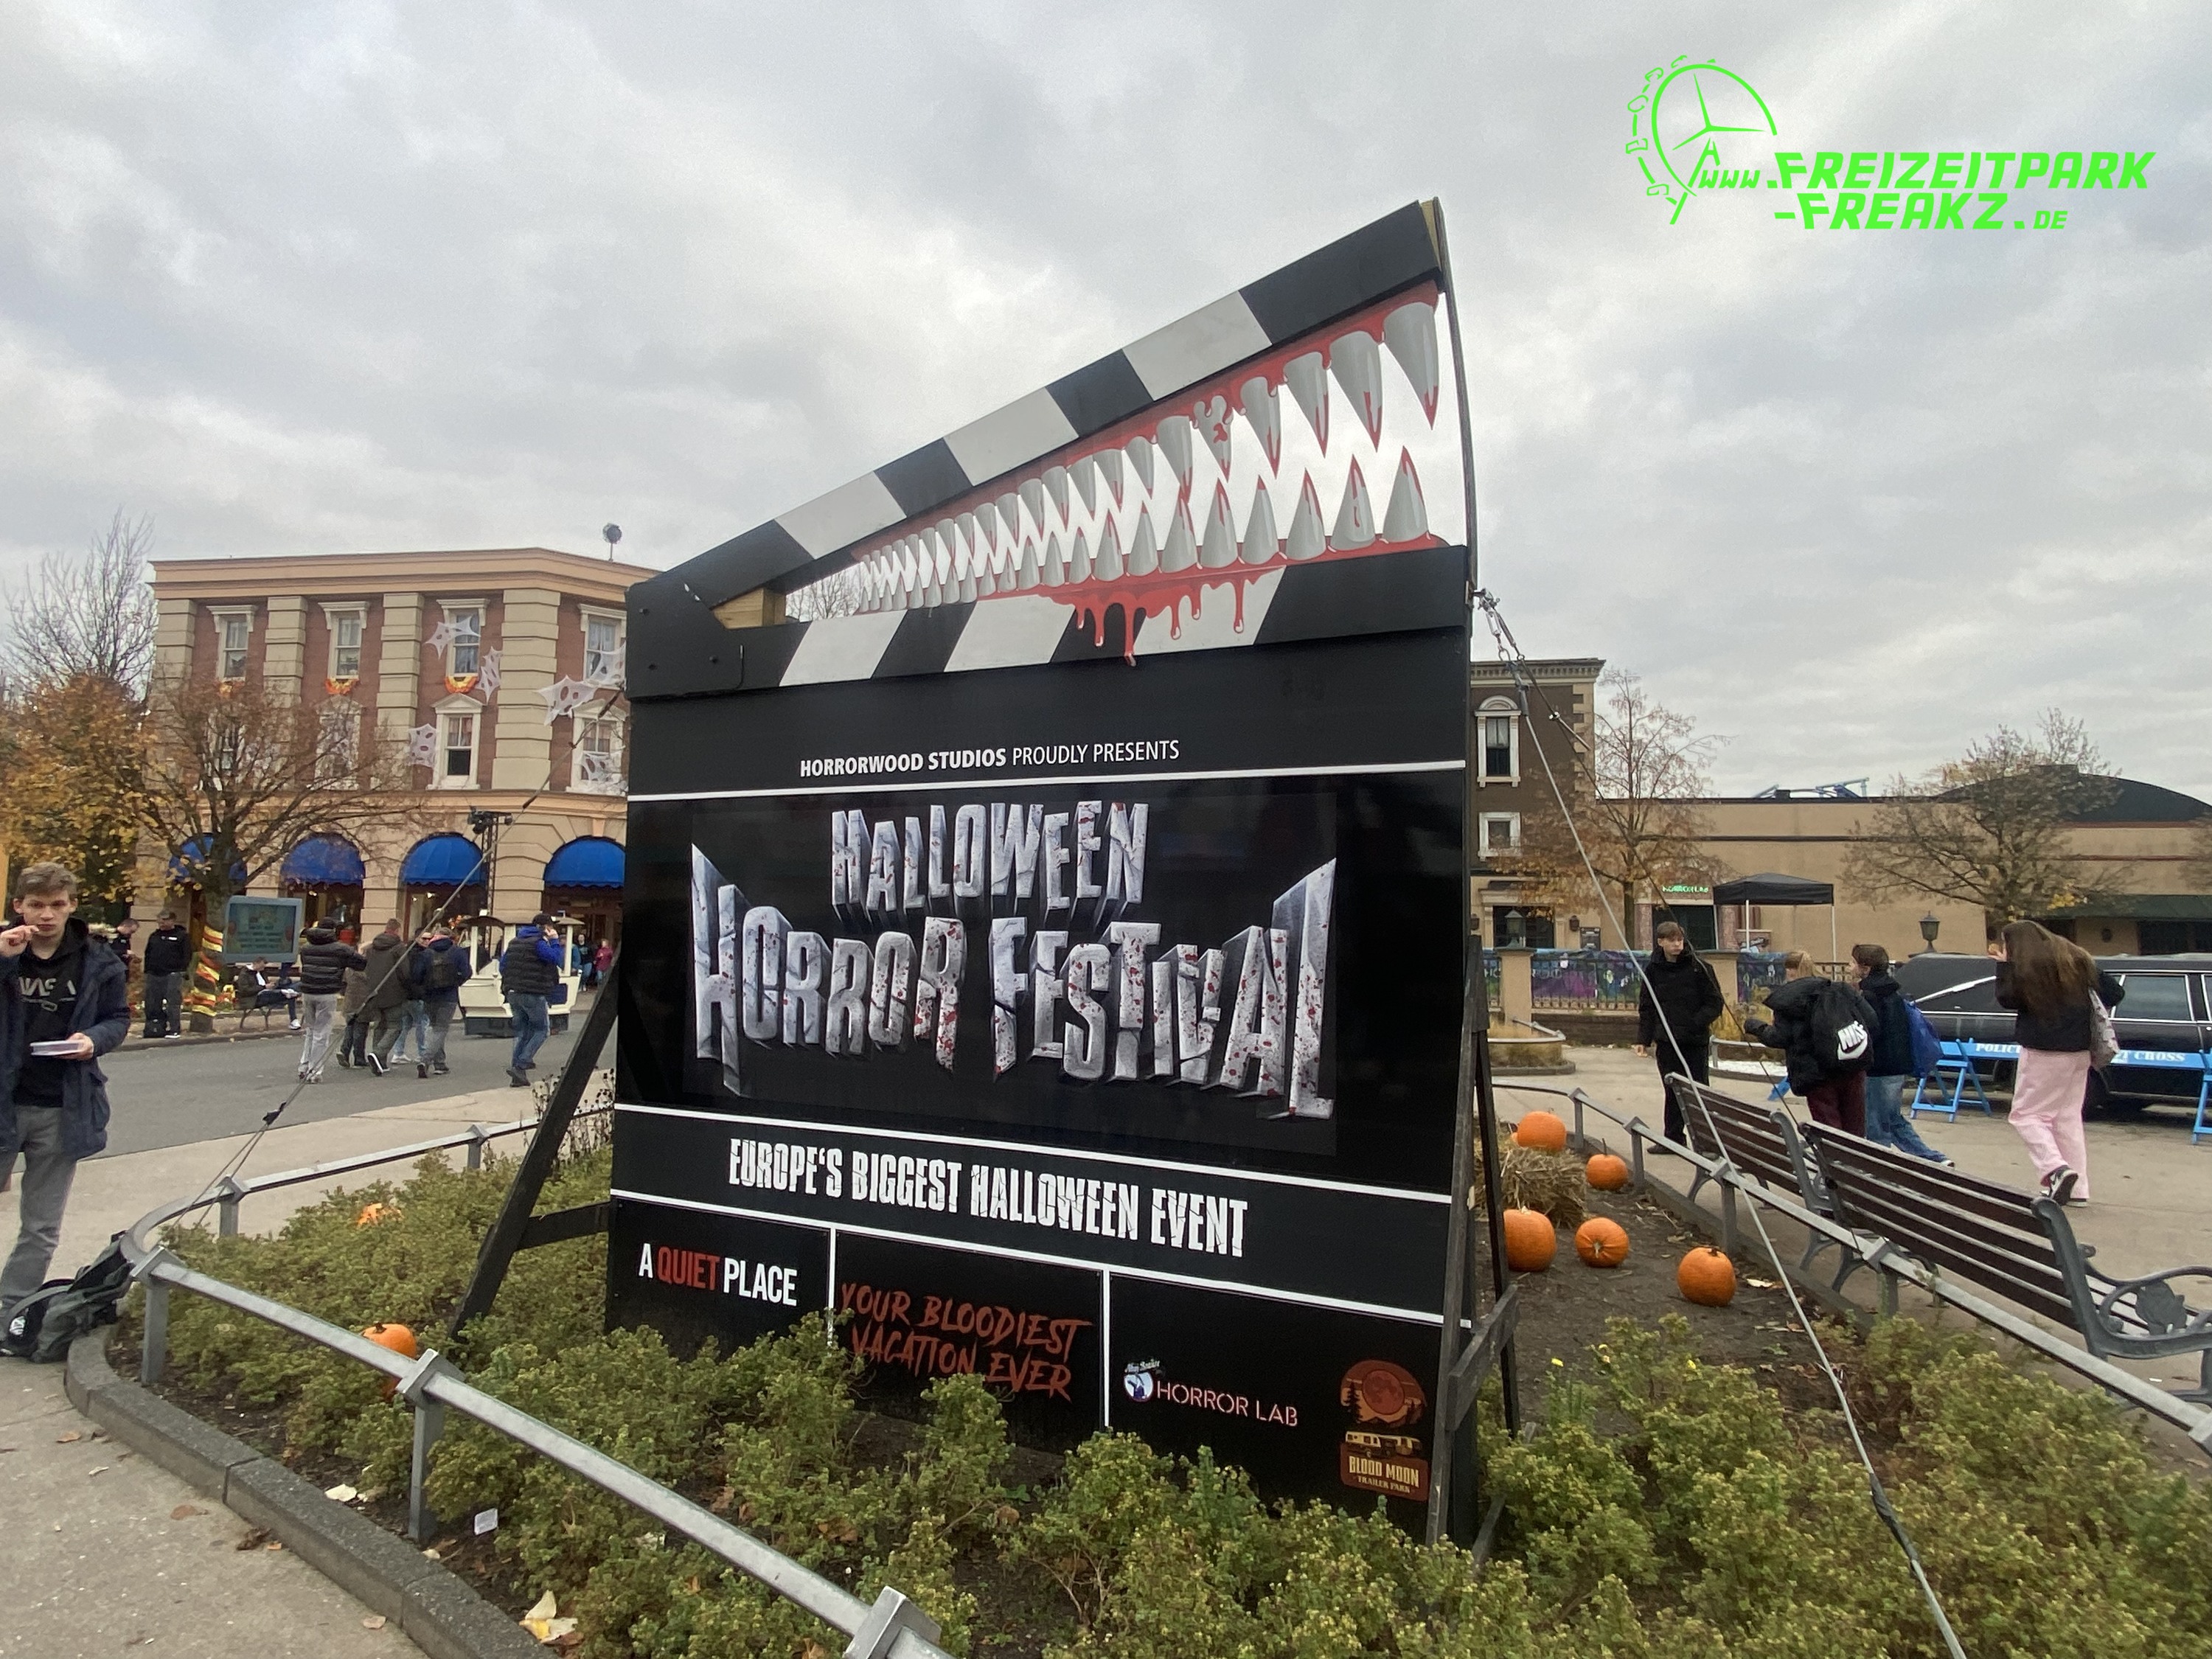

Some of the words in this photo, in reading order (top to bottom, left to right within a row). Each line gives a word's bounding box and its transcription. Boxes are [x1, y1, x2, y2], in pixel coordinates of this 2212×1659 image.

[800, 753, 923, 777] HORRORWOOD
[928, 748, 1006, 771] STUDIOS
[1012, 744, 1089, 766] PROUDLY
[1093, 740, 1180, 762] PRESENTS
[831, 800, 1150, 914] HALLOWEEN
[692, 844, 967, 1096] HORROR
[990, 858, 1336, 1119] FESTIVAL
[2134, 1051, 2185, 1062] CROSS
[851, 1150, 961, 1214] BIGGEST
[970, 1164, 1139, 1241] HALLOWEEN
[1150, 1188, 1248, 1257] EVENT
[639, 1242, 653, 1279] A
[657, 1245, 720, 1291] QUIET
[723, 1256, 798, 1307] PLACE
[841, 1282, 911, 1326] YOUR
[915, 1295, 1094, 1363] BLOODIEST
[852, 1318, 978, 1377] VACATION
[984, 1349, 1073, 1405] EVER
[1157, 1380, 1249, 1417] HORROR
[1256, 1399, 1298, 1427] LAB
[1349, 1455, 1382, 1477] BLOOD
[1385, 1463, 1419, 1489] MOON
[1357, 1475, 1389, 1489] TRAILER
